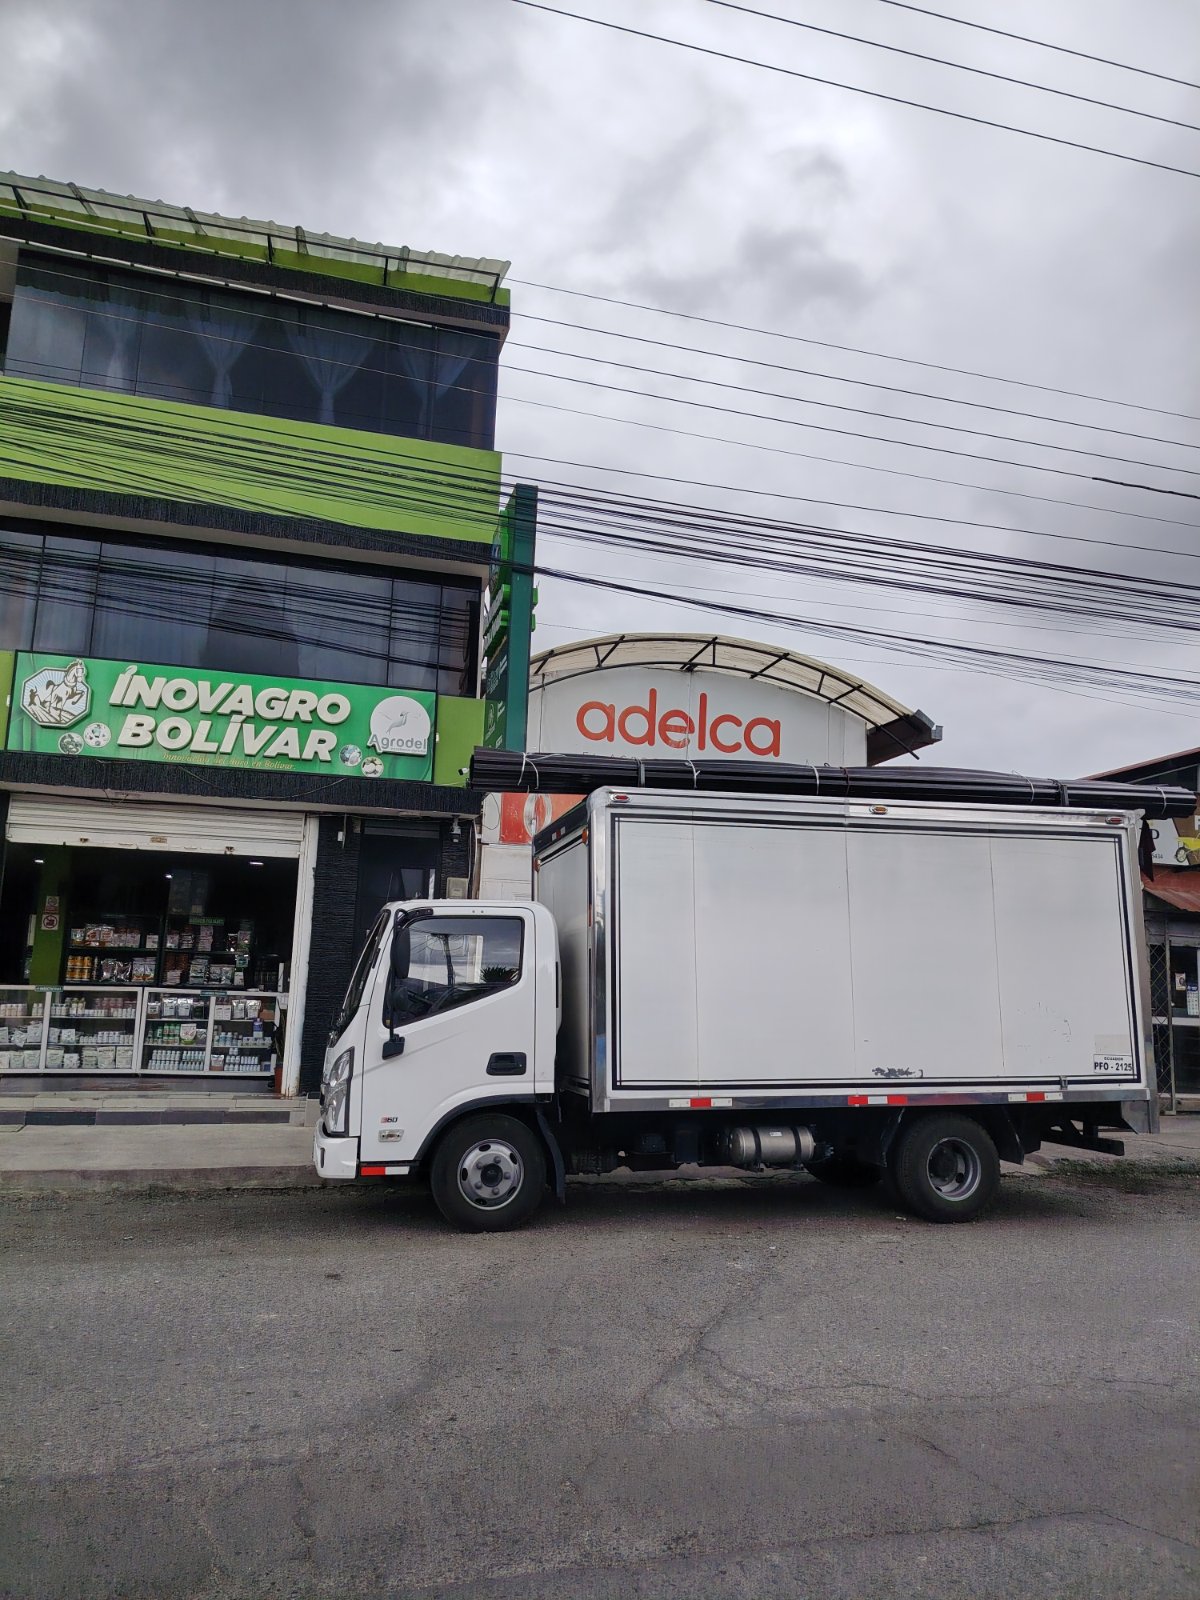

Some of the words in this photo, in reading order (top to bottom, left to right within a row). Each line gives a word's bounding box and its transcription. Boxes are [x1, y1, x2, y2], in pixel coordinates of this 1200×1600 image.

[117, 713, 338, 763] BOLÍVAR
[576, 687, 781, 758] adelca
[369, 734, 427, 751] Agrodel
[1094, 1062, 1109, 1071] PFO
[1115, 1062, 1133, 1071] 2125
